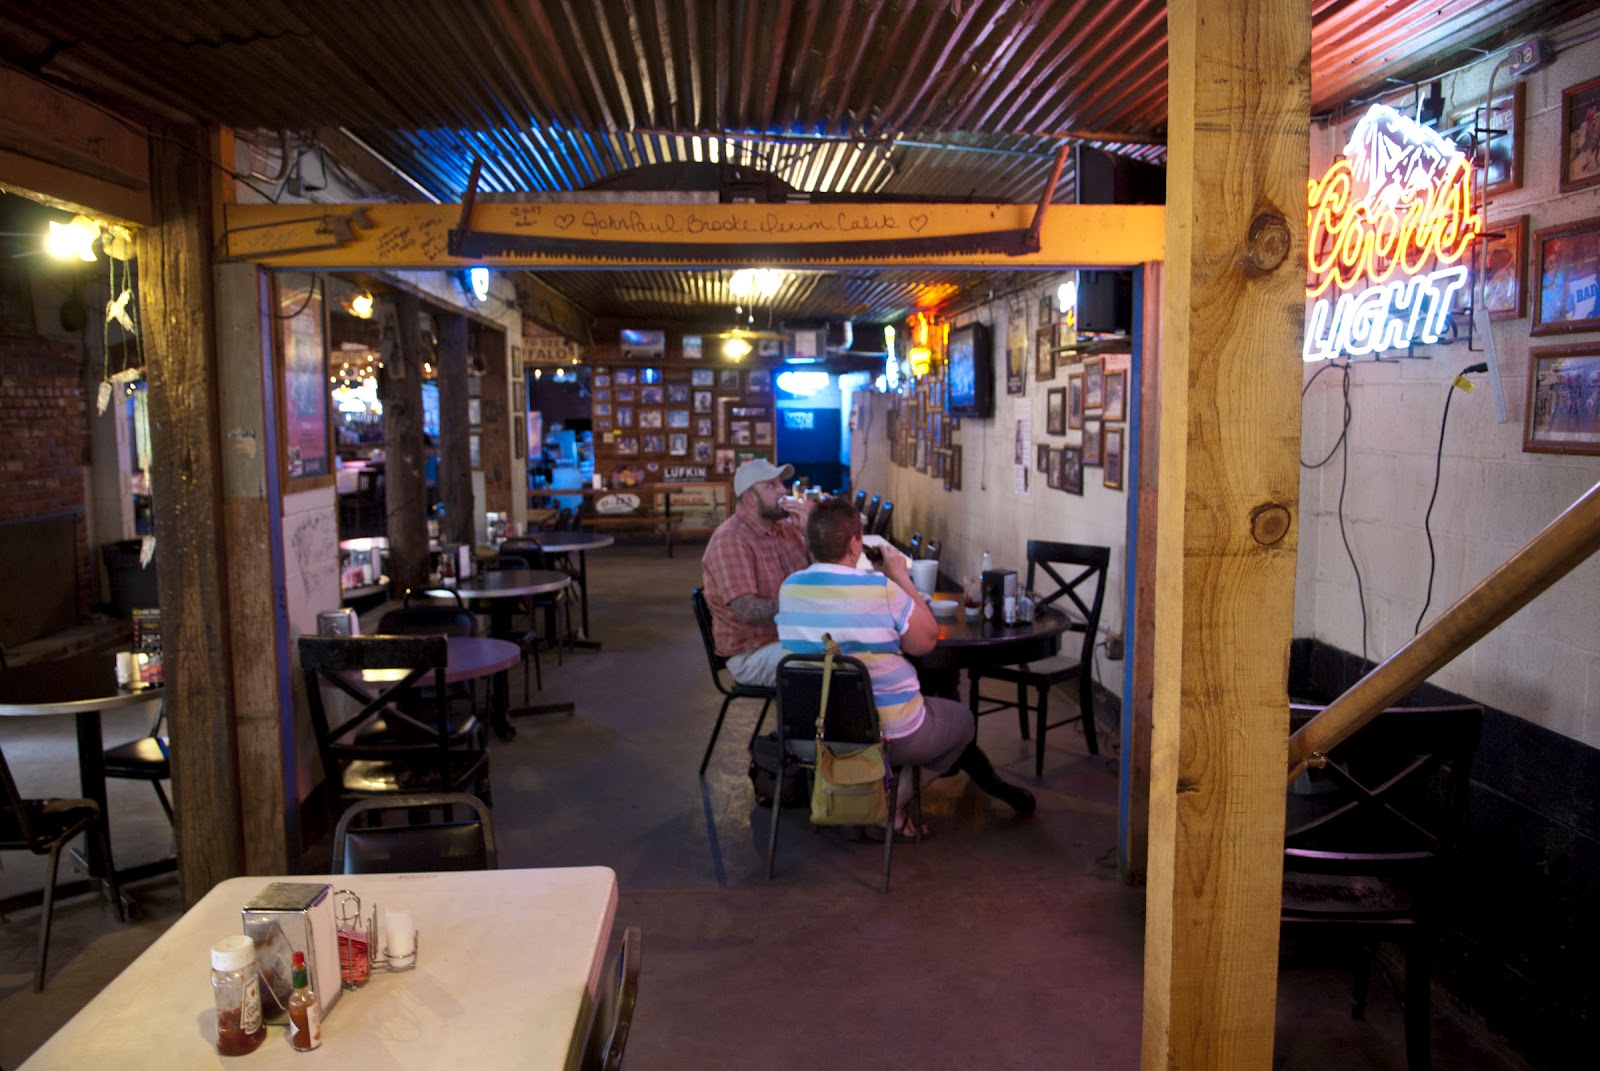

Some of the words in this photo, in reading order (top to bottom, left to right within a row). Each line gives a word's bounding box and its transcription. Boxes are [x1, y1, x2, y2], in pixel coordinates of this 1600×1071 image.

[1307, 159, 1481, 298] Coors
[1303, 265, 1468, 362] LIGHT
[664, 467, 707, 478] LUFKIN
